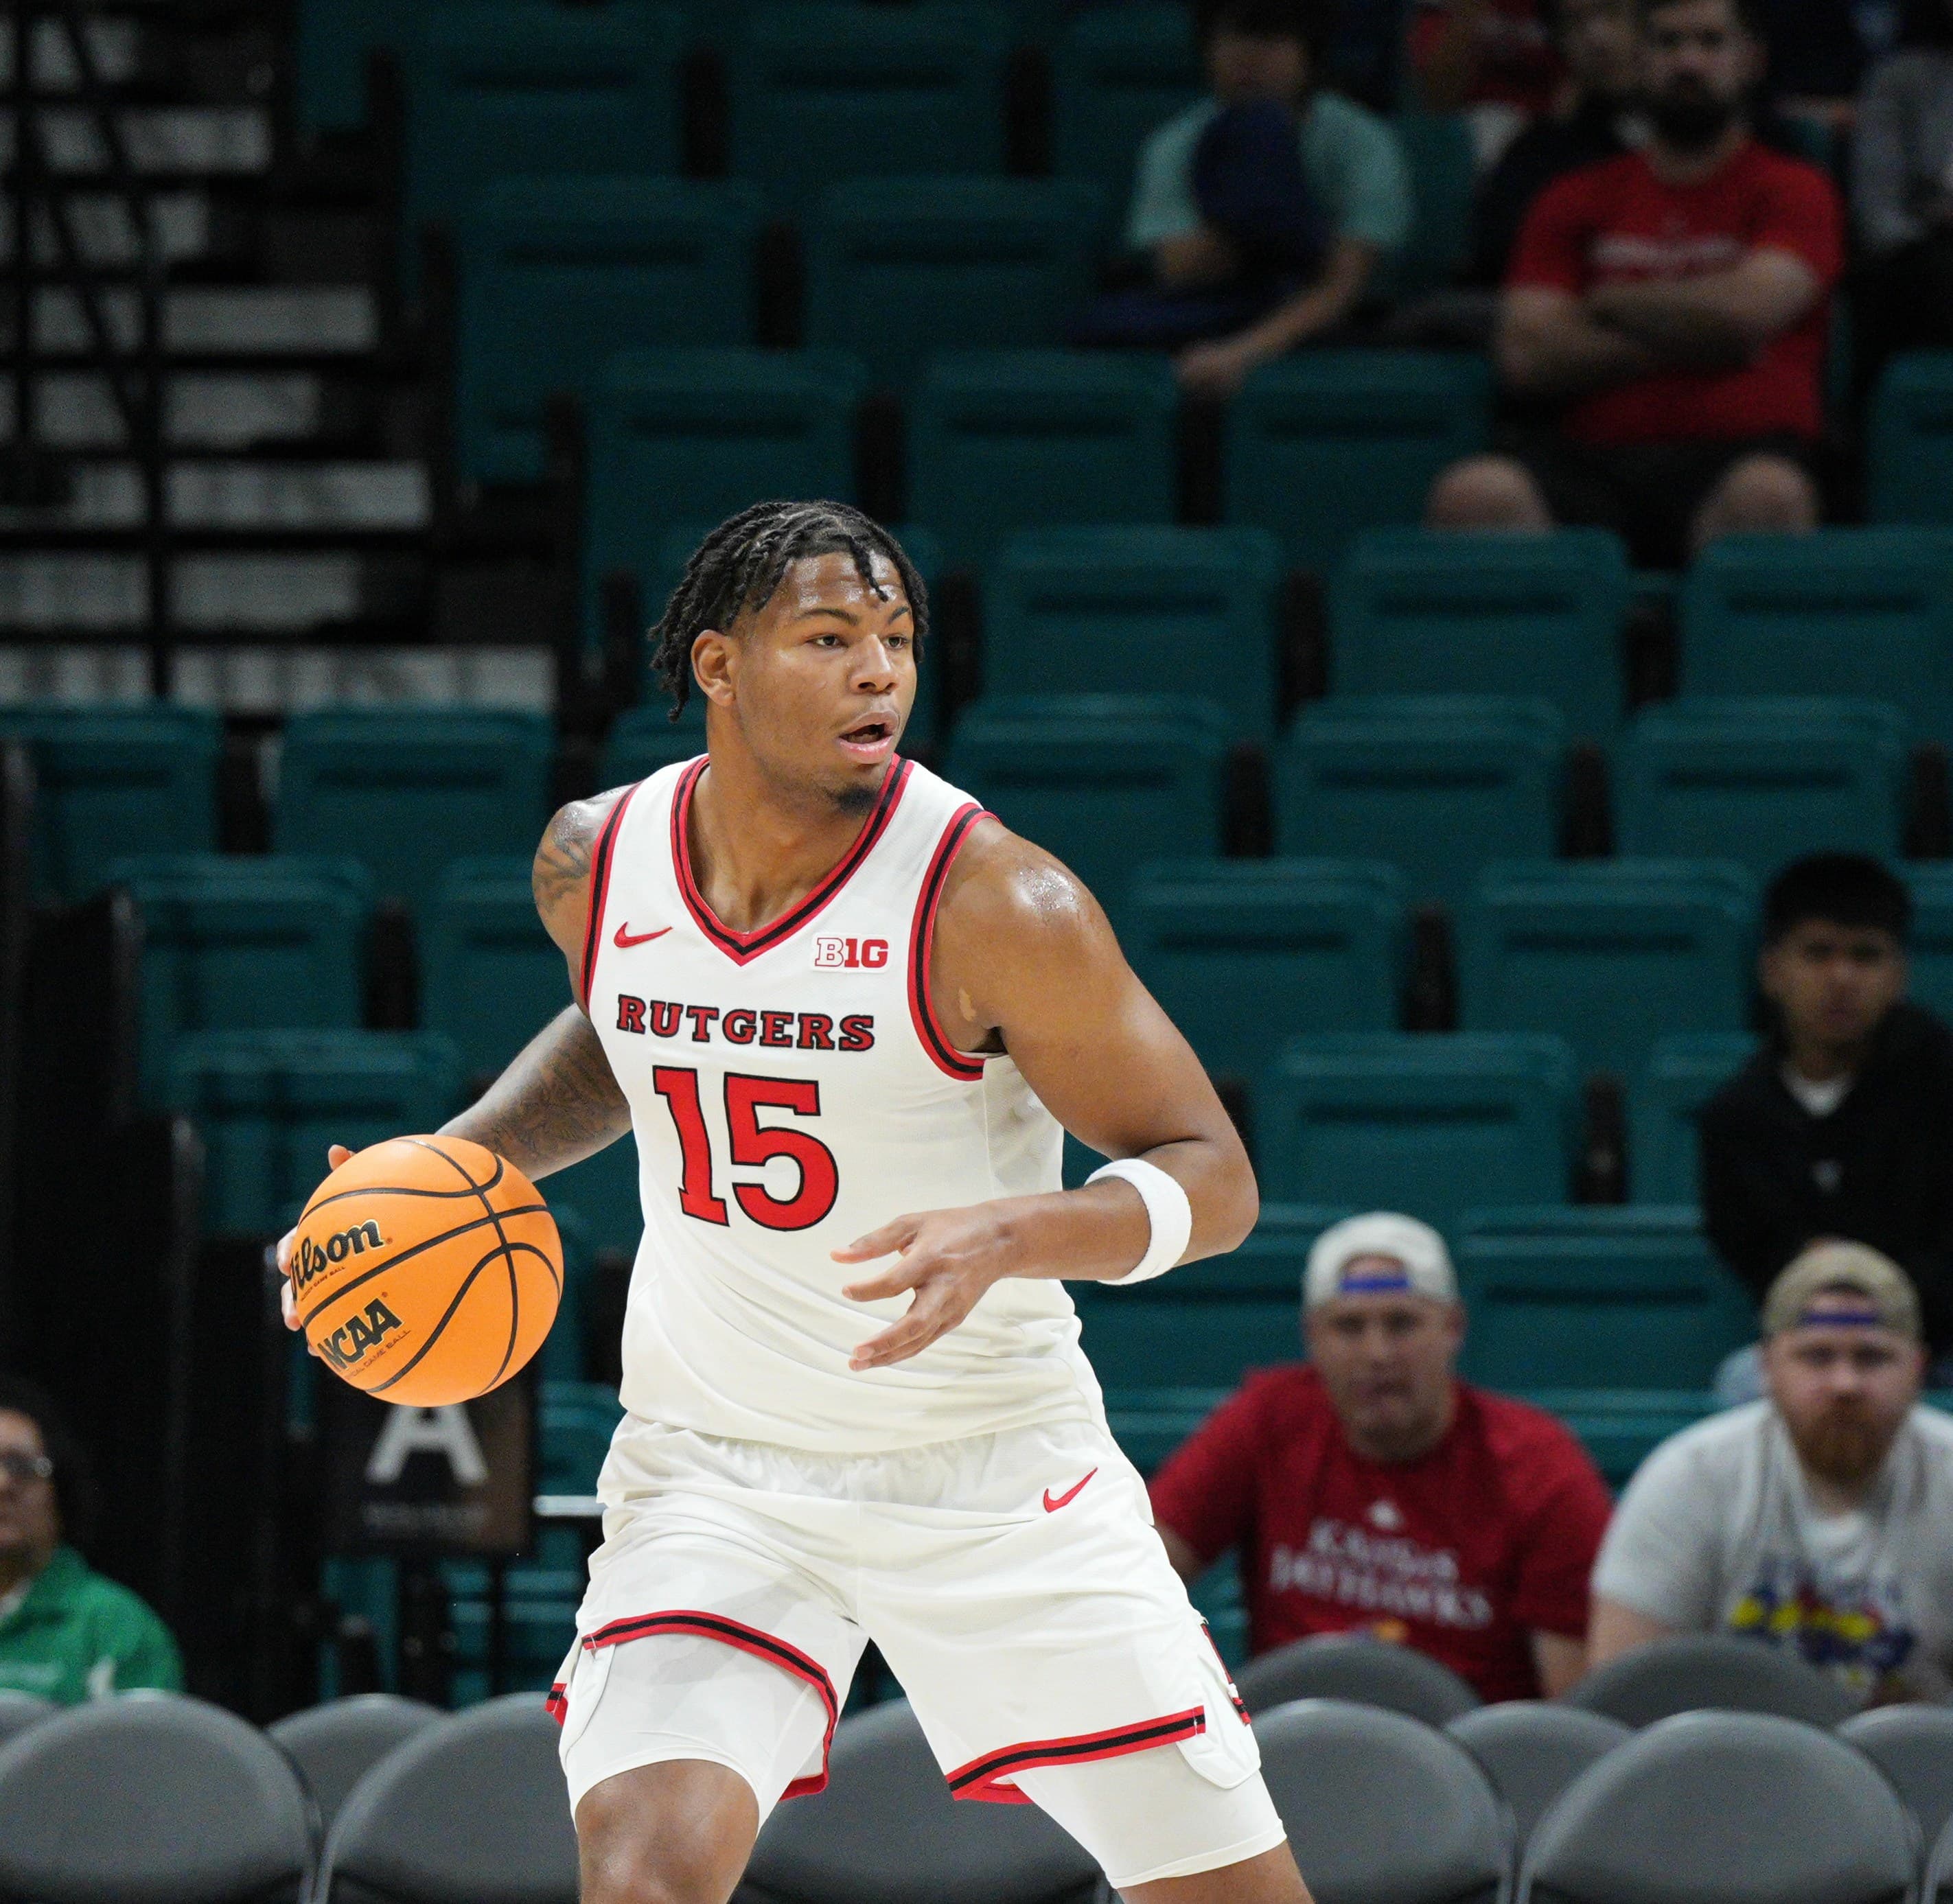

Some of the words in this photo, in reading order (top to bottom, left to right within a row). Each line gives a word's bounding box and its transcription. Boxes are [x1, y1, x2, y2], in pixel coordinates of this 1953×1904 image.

[616, 994, 875, 1052] RUTGERS
[652, 1065, 839, 1232] 15
[316, 1297, 403, 1371] NCAA
[363, 1348, 386, 1367] GAME
[386, 1330, 411, 1349] BALL
[365, 1404, 489, 1485] A
